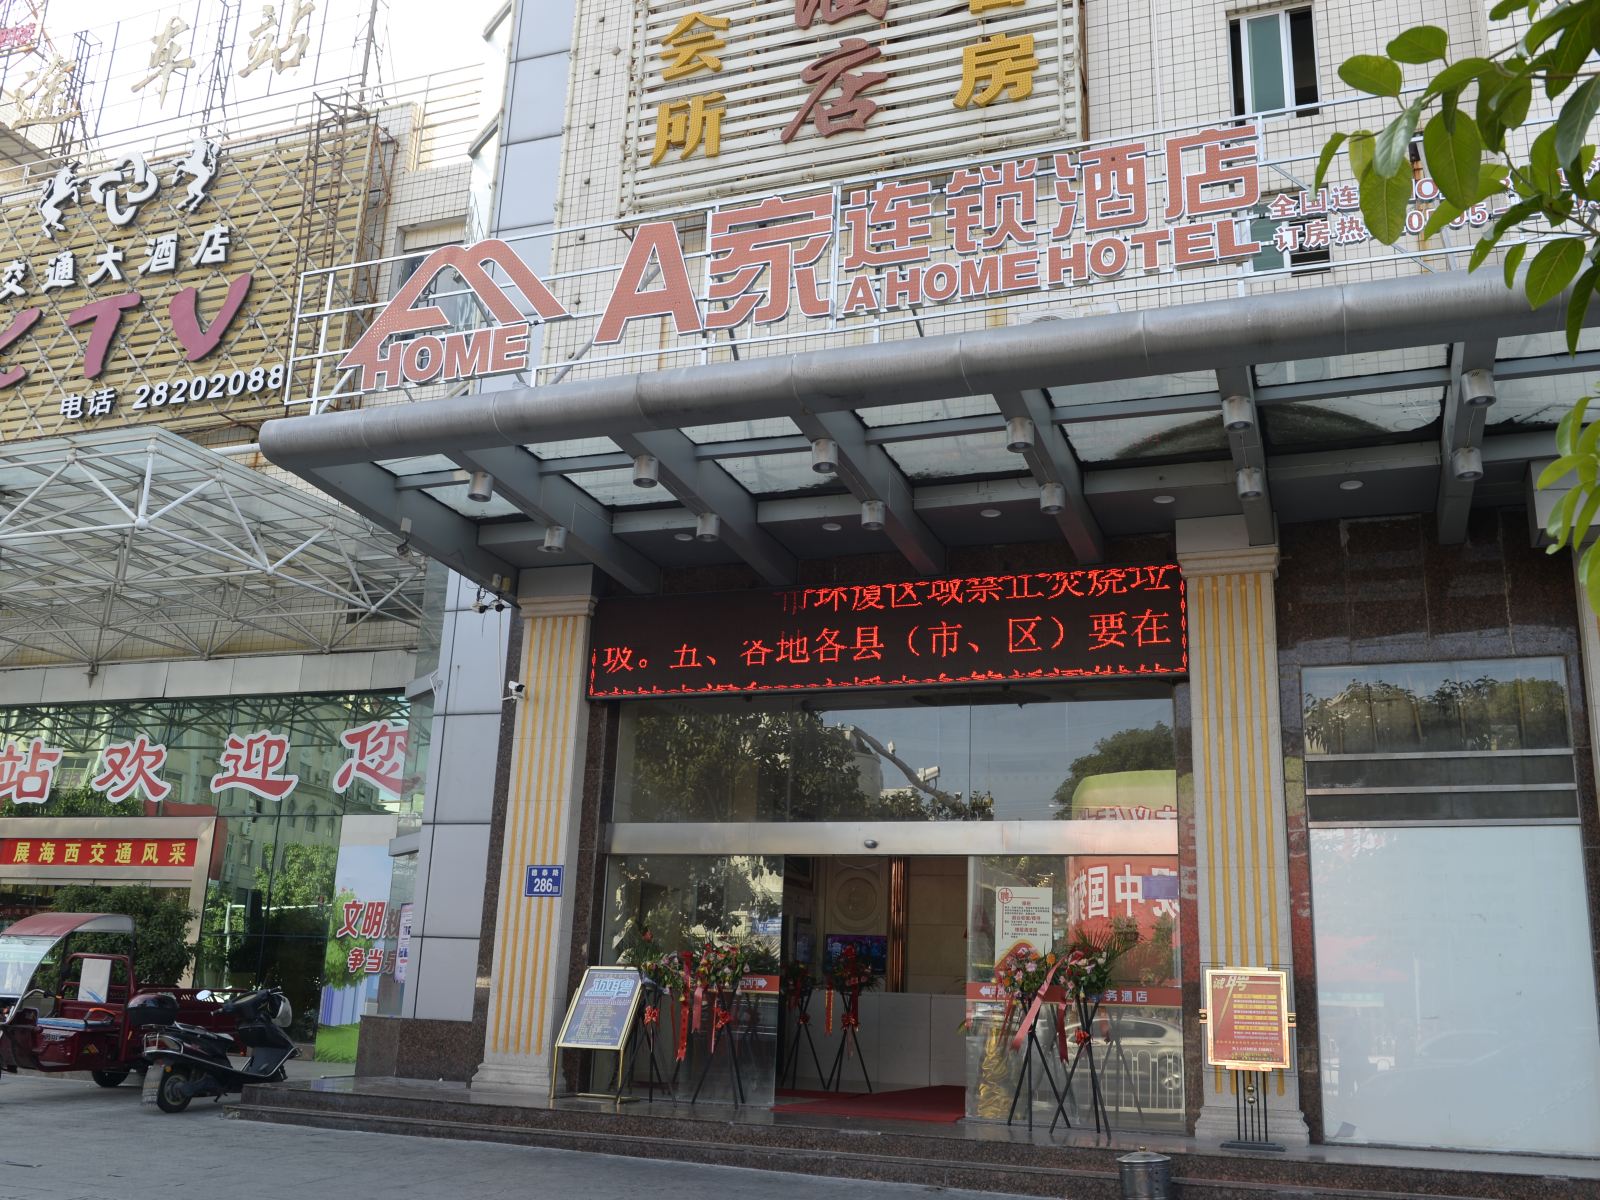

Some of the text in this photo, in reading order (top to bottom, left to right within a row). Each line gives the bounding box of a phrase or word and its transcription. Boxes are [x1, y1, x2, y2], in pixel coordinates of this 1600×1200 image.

[651, 12, 731, 166] 会所
[952, 0, 1039, 109] 房
[0, 224, 230, 299] 交通大酒店
[593, 124, 1261, 345] A家连锁酒店
[1047, 219, 1262, 285] HOTEL
[59, 364, 285, 418] 电话 28202088
[13, 842, 187, 864] 展海西交通风采
